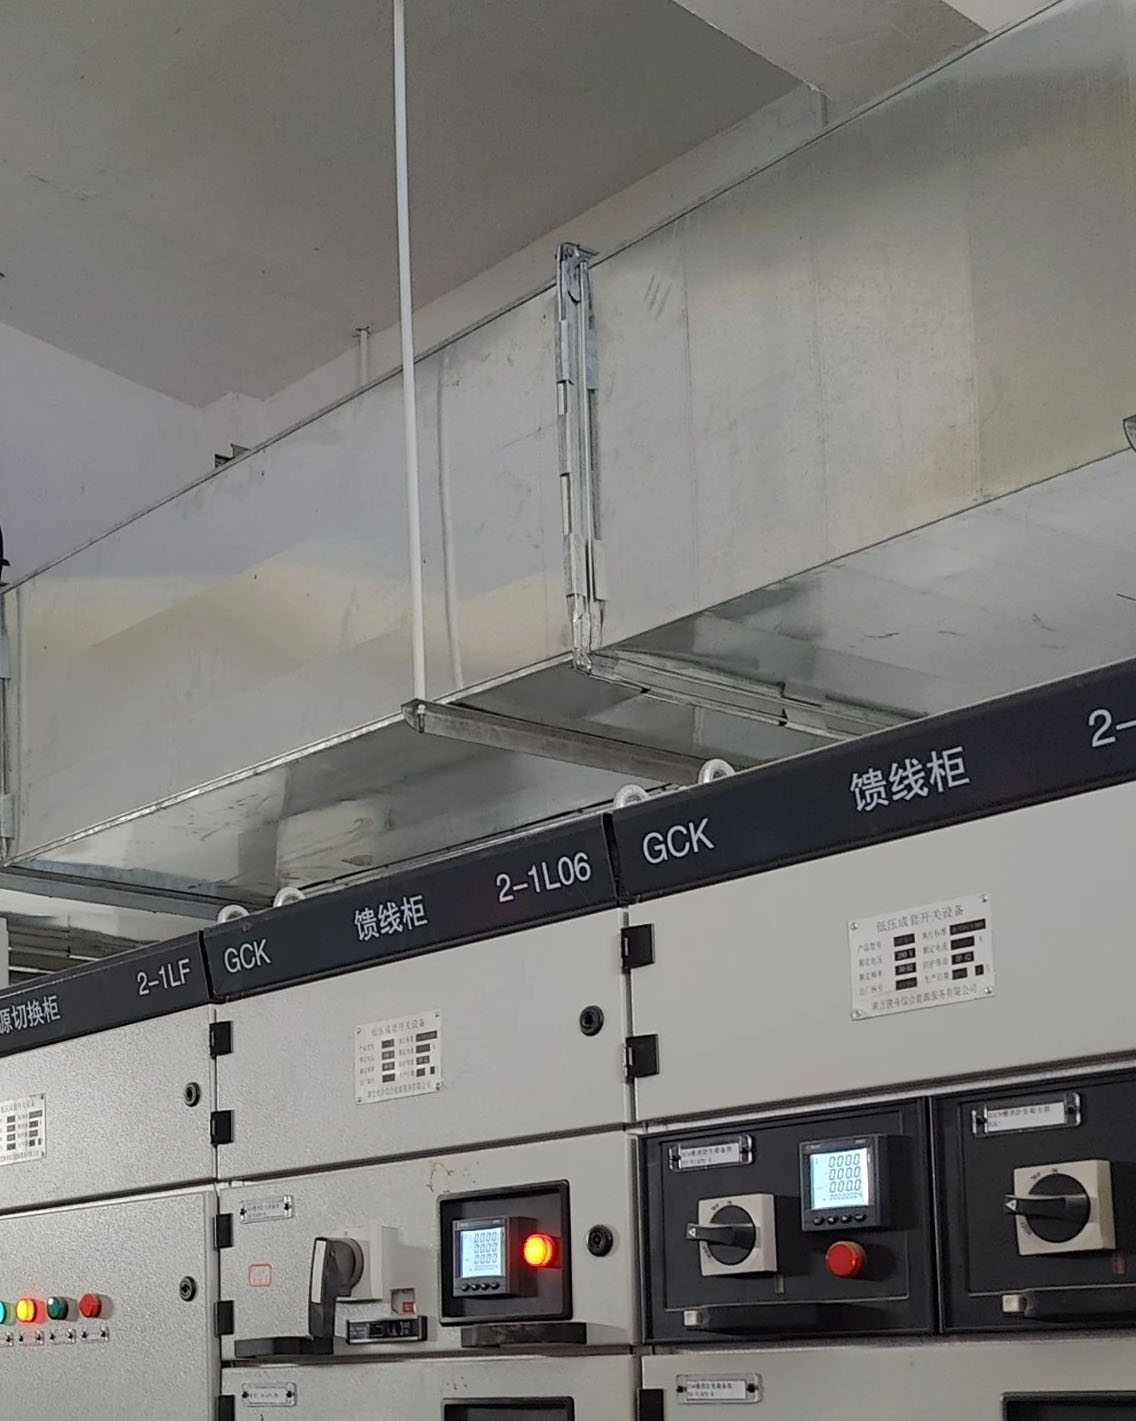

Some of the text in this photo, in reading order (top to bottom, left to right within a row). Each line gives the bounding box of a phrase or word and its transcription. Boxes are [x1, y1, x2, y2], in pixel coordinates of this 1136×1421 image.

[850, 745, 971, 814] 馈线柜
[643, 818, 715, 864] GCK
[496, 852, 592, 903] 2-1L06
[354, 895, 428, 941] 馈线柜
[137, 958, 190, 996] 2-1LF
[224, 938, 271, 973] GCK
